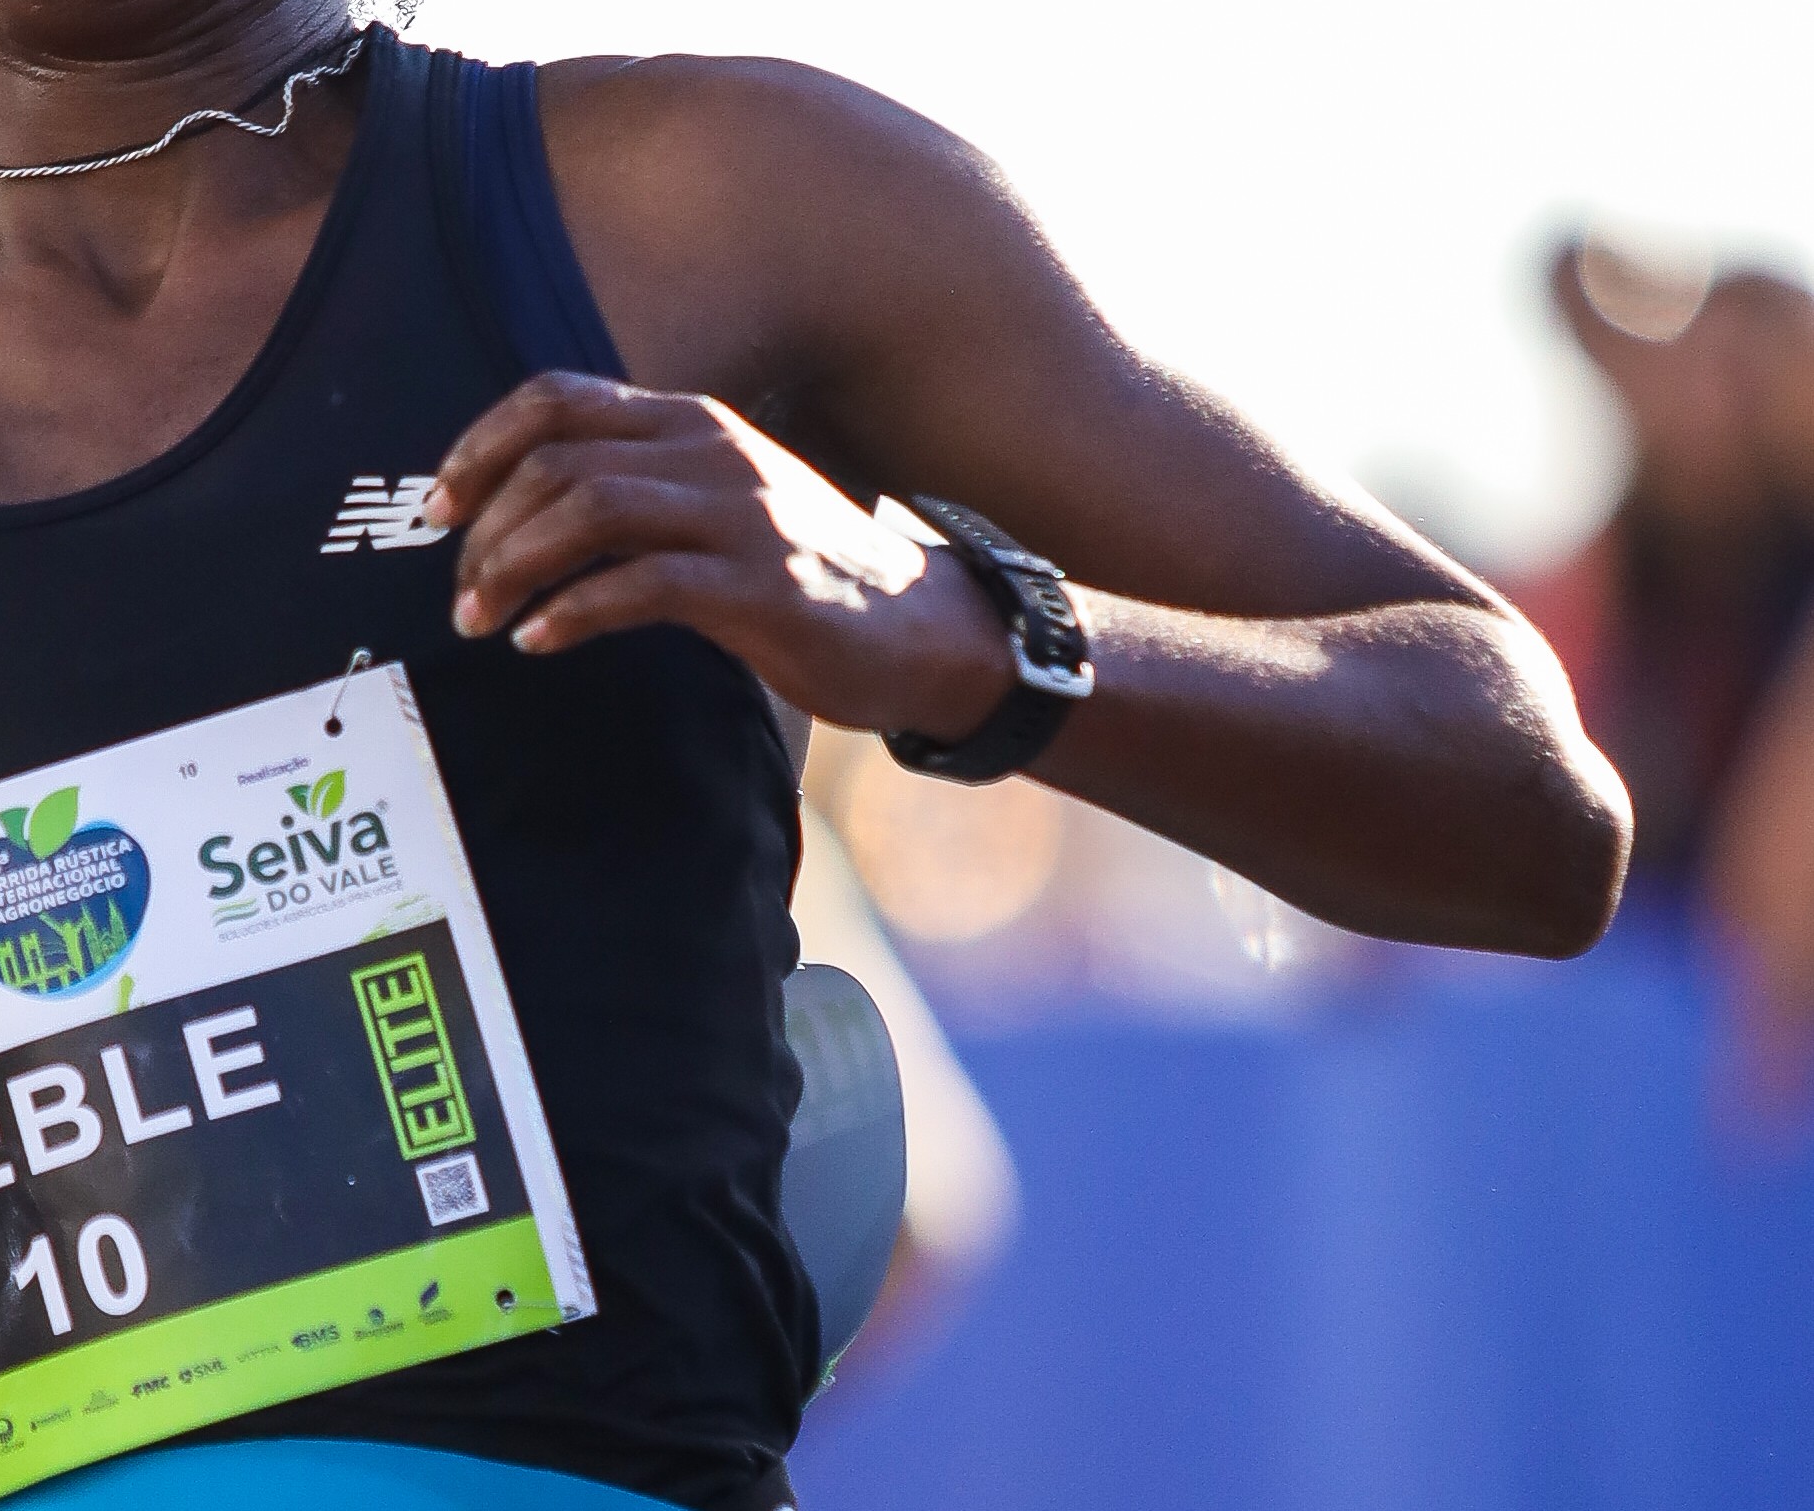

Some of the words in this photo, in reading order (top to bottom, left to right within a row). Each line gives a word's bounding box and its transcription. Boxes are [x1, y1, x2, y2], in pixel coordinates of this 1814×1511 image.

[179, 761, 198, 779] 10
[53, 838, 132, 874] RÚSTICA
[198, 810, 390, 899] Seiva
[266, 882, 311, 912] DO
[318, 856, 399, 895] VALE
[367, 968, 462, 1146] ELITE
[16, 1212, 149, 1336] 10
